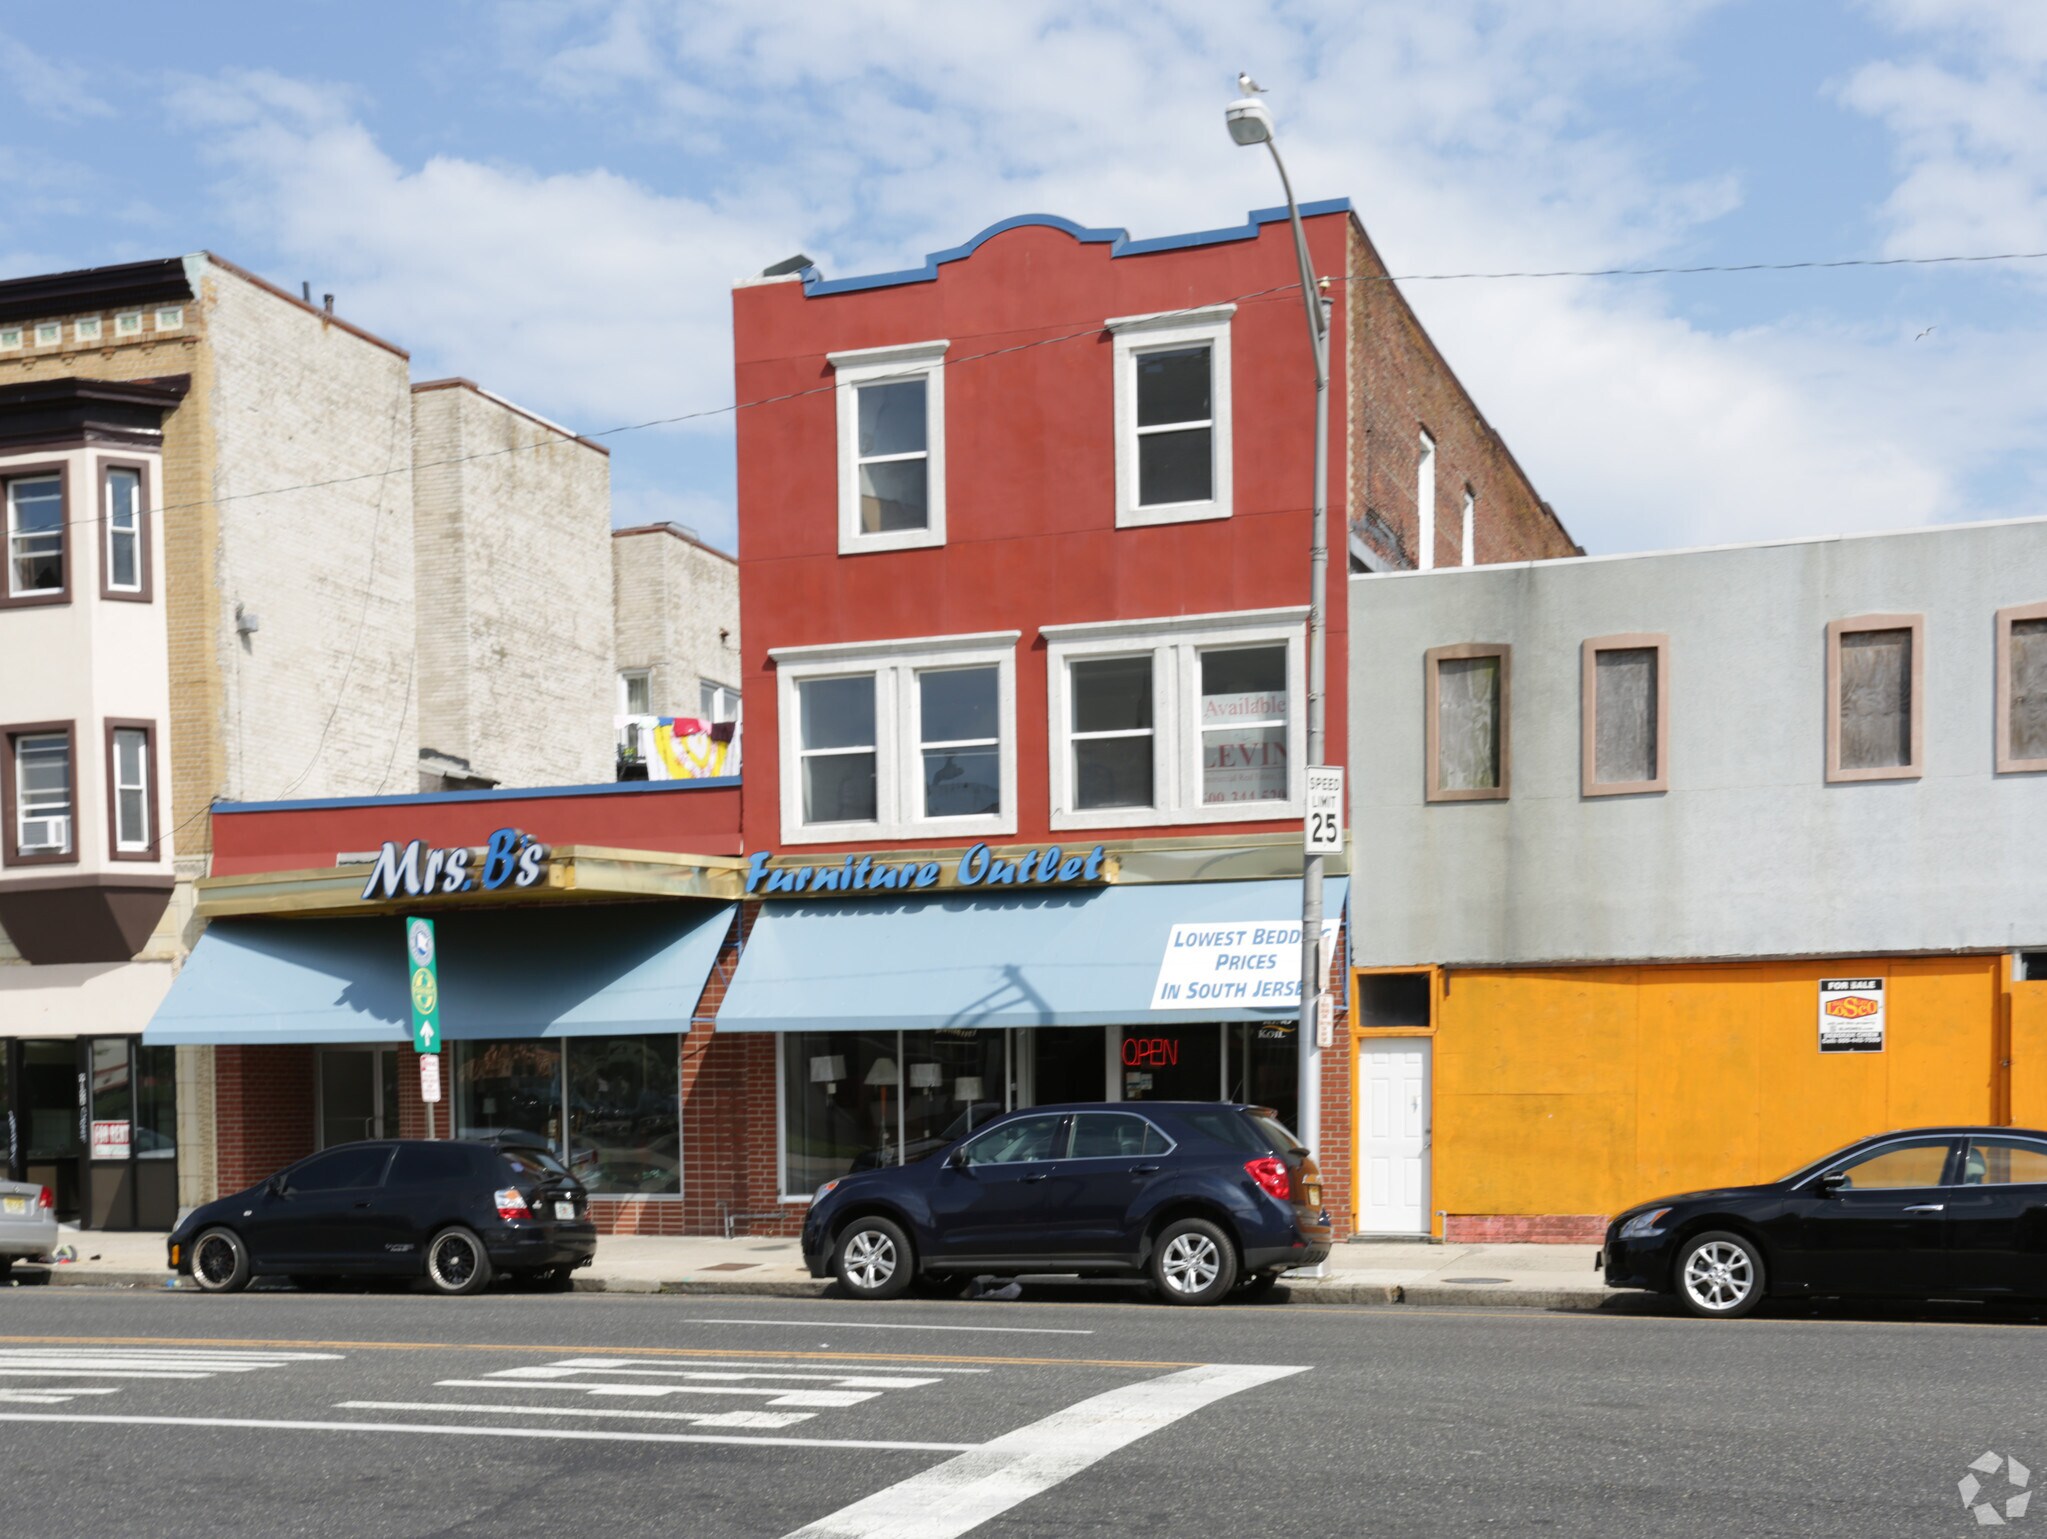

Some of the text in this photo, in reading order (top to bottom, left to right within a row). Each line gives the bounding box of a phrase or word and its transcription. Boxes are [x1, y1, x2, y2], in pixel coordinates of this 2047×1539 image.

[1206, 695, 1286, 717] Available
[1310, 777, 1340, 791] SPEED
[1312, 796, 1337, 808] LIMIT
[1312, 813, 1338, 843] 25
[361, 827, 545, 900] Mrs. B's
[745, 842, 1105, 895] Furniture Outlet
[1174, 930, 1247, 948] LOWEST
[1215, 954, 1278, 971] PRICES
[1160, 982, 1180, 1000] IN
[1186, 981, 1247, 999] SOUTH
[1827, 980, 1877, 990] FOR SALE
[1121, 1037, 1179, 1067] OPEN
